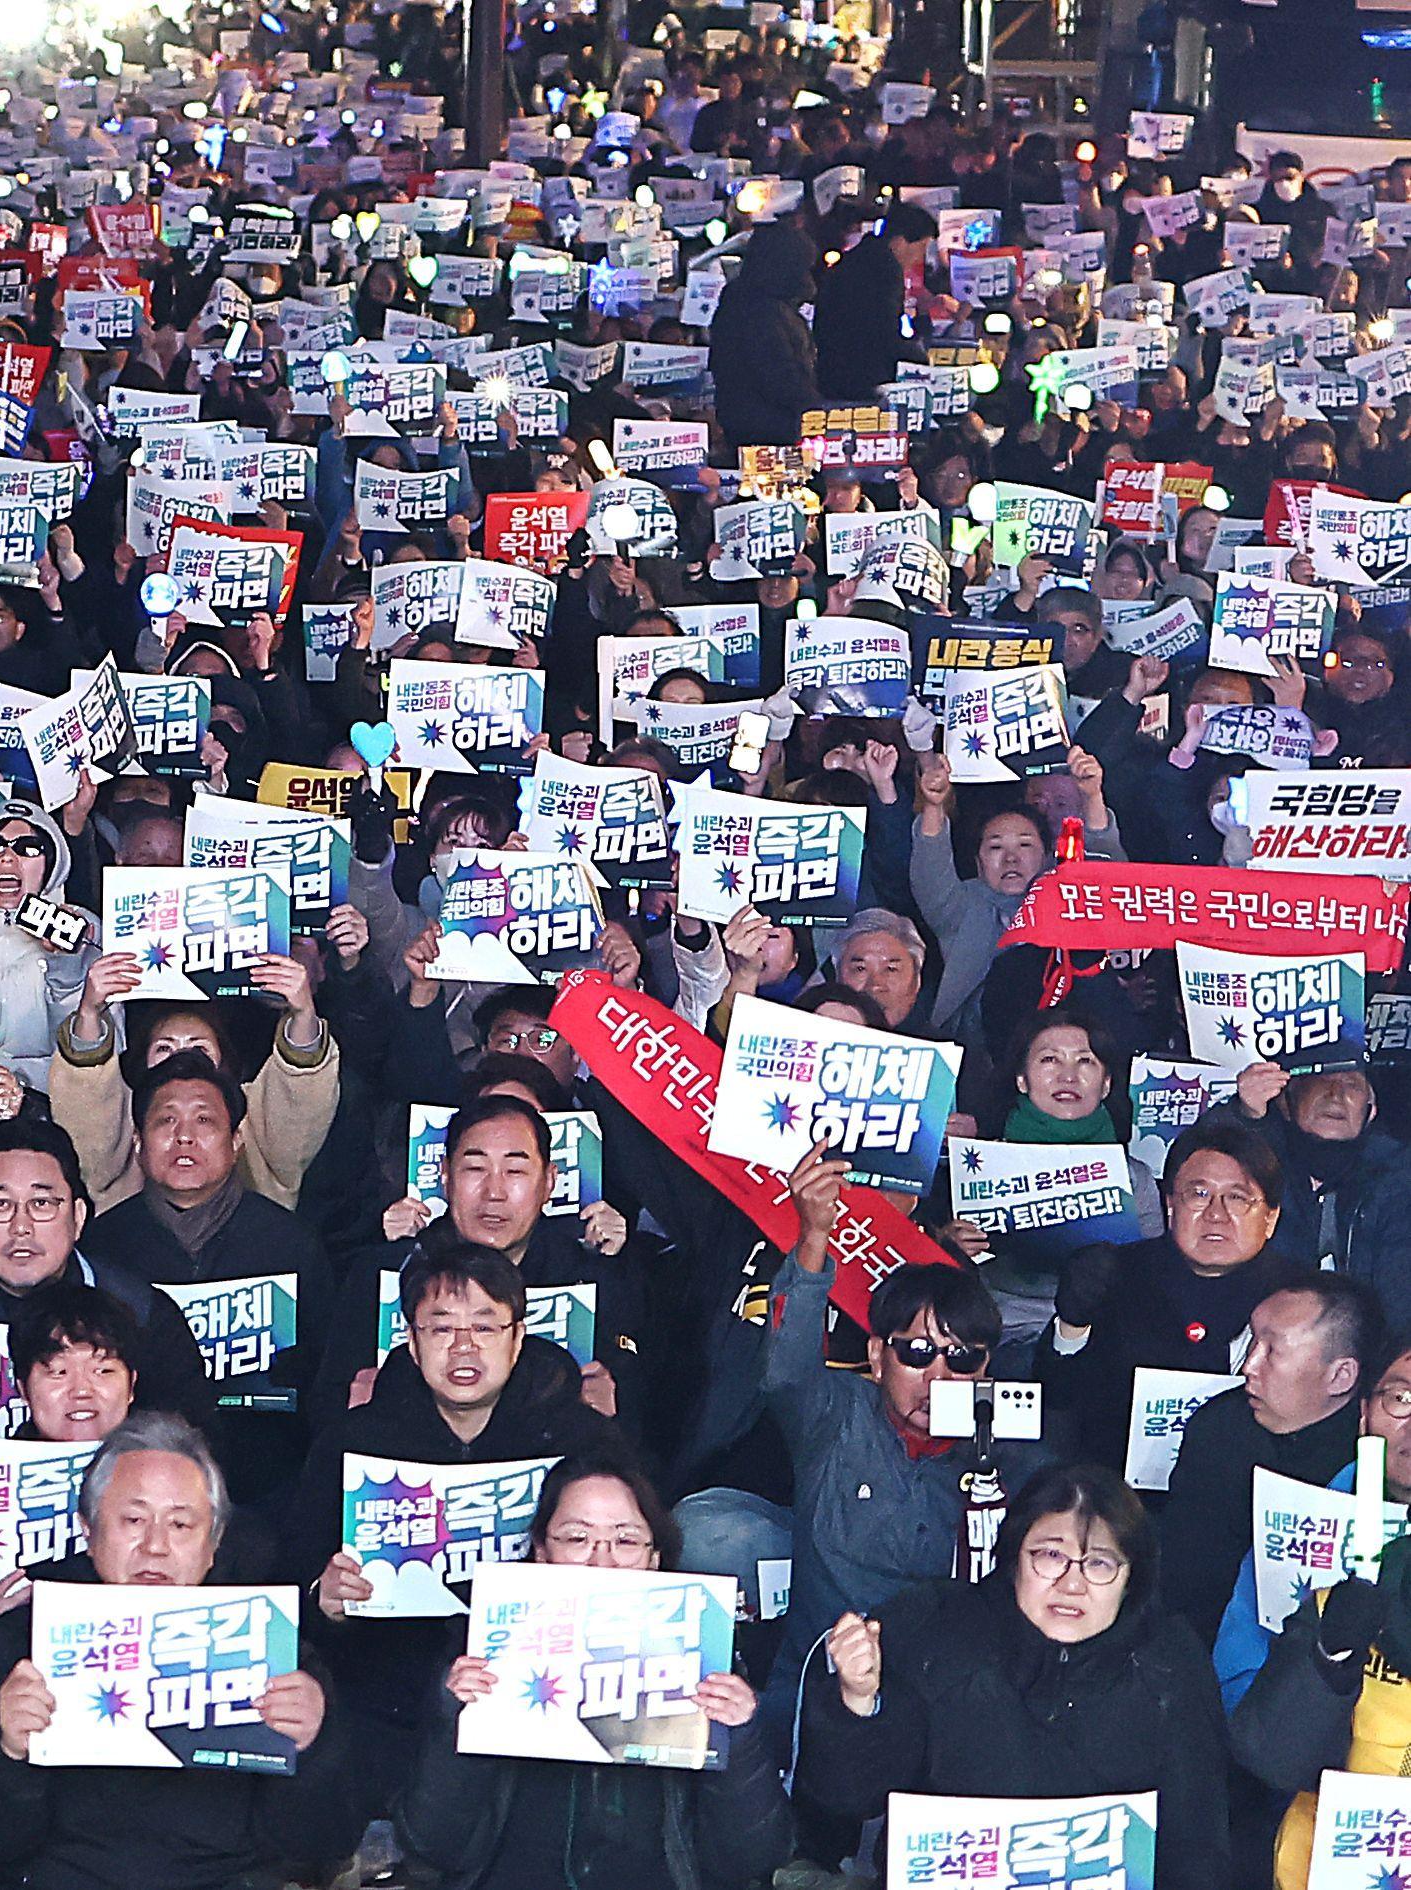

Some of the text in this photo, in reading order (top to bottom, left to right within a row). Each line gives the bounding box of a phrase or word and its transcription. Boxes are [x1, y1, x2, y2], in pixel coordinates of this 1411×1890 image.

[389, 368, 436, 397] 즉각
[388, 397, 434, 422] 파면
[262, 448, 307, 474] 즉각
[262, 449, 306, 474] 즉각
[31, 463, 76, 497] 즉각
[261, 474, 307, 500] 파면
[261, 474, 306, 501] 파면
[397, 472, 447, 500] 즉각
[397, 500, 447, 520] 파면
[510, 507, 569, 532] 윤석열
[746, 503, 795, 535] 즉각
[1030, 498, 1082, 528] 해체
[499, 532, 538, 555] 즉각
[748, 536, 796, 561] 파면
[1025, 528, 1076, 556] 하라
[216, 545, 274, 579] 즉각
[212, 578, 272, 609] 파면
[510, 607, 548, 638] 파면
[1221, 609, 1269, 628] 윤석열
[790, 635, 901, 664] 내란수괴 윤석열은
[927, 638, 1053, 667] 내란 종식
[1270, 626, 1323, 658] 파면
[828, 660, 907, 686] 퇴진하라!
[397, 681, 452, 698] 내란동조
[455, 674, 526, 711] 해체
[397, 696, 450, 712] 국민의힘
[136, 721, 198, 755] 파면
[1339, 756, 1364, 769] M
[541, 778, 599, 801] 내란수괴
[1270, 784, 1401, 817] 국힘당을
[538, 799, 596, 821] 윤석열
[694, 813, 753, 834] 내란수괴
[191, 836, 249, 854] 내란수괴
[692, 834, 750, 856] 윤석열
[1252, 825, 1410, 860] 해산하라!
[114, 889, 180, 911] 내란수괴
[186, 875, 270, 926] 즉각
[443, 878, 504, 901] 내란동조
[441, 897, 503, 920] 국민의힘
[1059, 883, 1104, 920] 모든
[1111, 885, 1198, 924] 권력은
[1206, 890, 1367, 937] 국민으로부터
[114, 909, 179, 938] 윤석열
[511, 911, 594, 957] 하라
[184, 924, 268, 974] 파면
[1186, 970, 1247, 990] 내란동조
[1253, 961, 1341, 1013] 해체
[1188, 988, 1247, 1008] 국민의힘
[1255, 1006, 1343, 1057] 하라
[738, 1034, 818, 1059] 내란동조
[736, 1056, 814, 1082] 국민의힘
[820, 1042, 931, 1101] 해체
[1139, 1088, 1202, 1107] 내란수괴
[812, 1100, 921, 1154] 하라
[1138, 1106, 1199, 1126] 윤석열
[961, 1162, 1108, 1201] 내란수괴 윤석열은
[1013, 1190, 1123, 1231] 퇴진하라!
[186, 1282, 273, 1341] 해체
[355, 1496, 437, 1520] 내란수괴
[354, 1517, 436, 1551] 윤석열
[1265, 1511, 1337, 1538] 내란수괴
[1265, 1533, 1334, 1570] 윤석열
[49, 1622, 142, 1645] 내란수괴
[150, 1598, 273, 1667] 즉각
[580, 1588, 706, 1656] 즉각
[482, 1625, 576, 1659] 윤석열
[49, 1641, 141, 1679] 윤석열
[580, 1650, 700, 1723] 파면
[906, 1827, 1000, 1853] 내란수괴
[1008, 1805, 1131, 1880] 즉각
